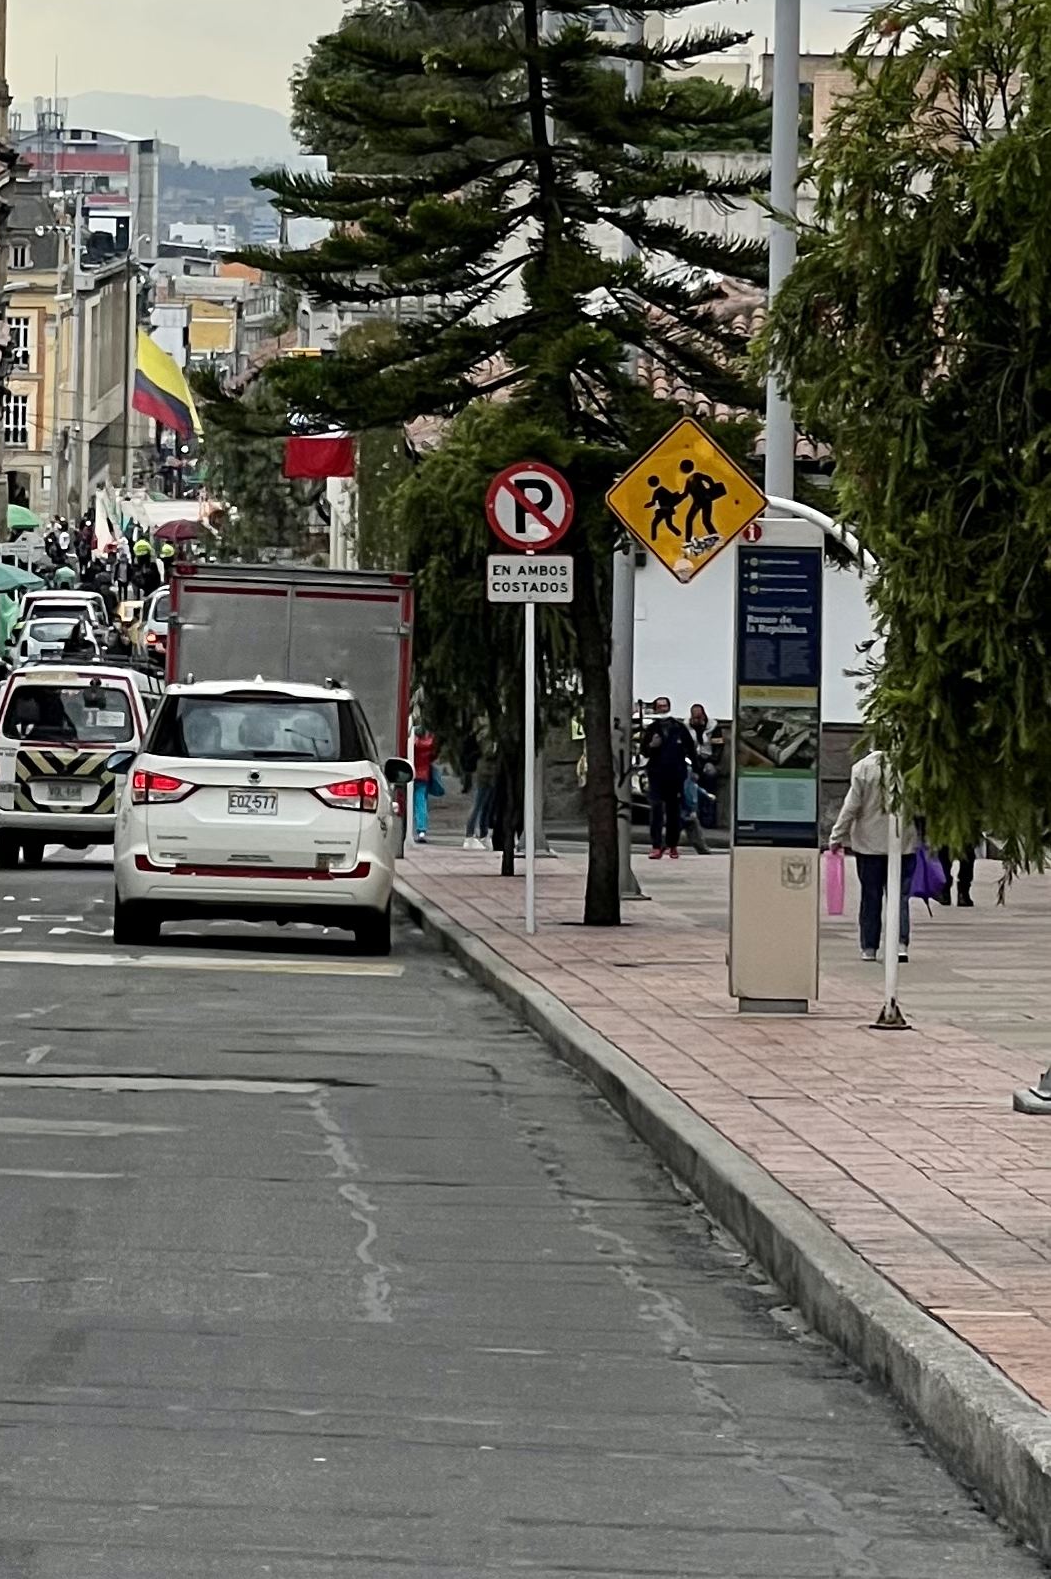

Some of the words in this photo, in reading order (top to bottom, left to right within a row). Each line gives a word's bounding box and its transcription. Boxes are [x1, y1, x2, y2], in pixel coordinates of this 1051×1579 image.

[514, 479, 553, 534] P
[492, 565, 511, 576] EN
[517, 565, 568, 576] AMBOS
[492, 582, 568, 593] COSTADOS
[779, 615, 792, 624] de
[746, 623, 756, 633] la
